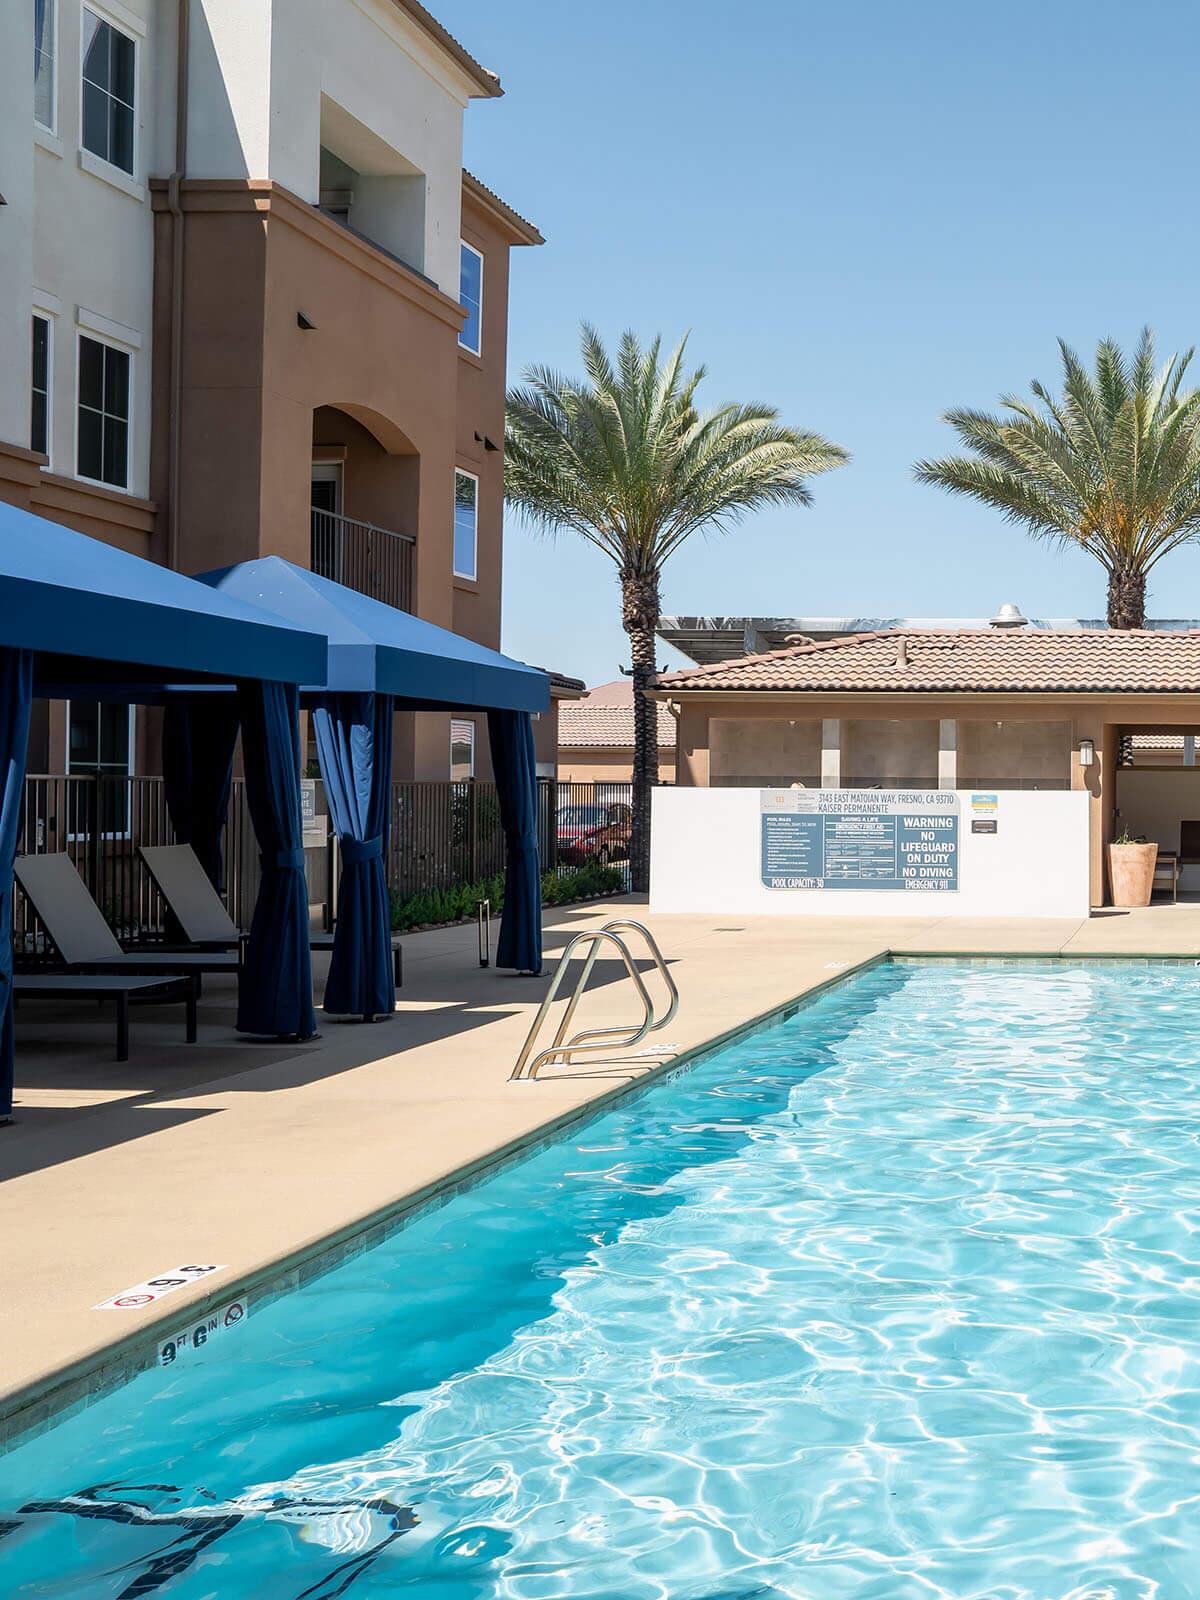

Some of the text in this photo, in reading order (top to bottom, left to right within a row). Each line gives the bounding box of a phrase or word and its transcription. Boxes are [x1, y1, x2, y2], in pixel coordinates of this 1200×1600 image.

[819, 794, 832, 802] 3143
[834, 794, 848, 803] EAST
[880, 794, 896, 804] WAY,
[898, 795, 925, 804] FRESNO,
[926, 795, 935, 804] CA
[936, 795, 954, 804] 93710
[819, 804, 889, 813] KAISER PERMANENTE
[904, 818, 953, 828] WARNING
[921, 832, 935, 841] NO
[901, 843, 955, 852] LIFEGUARD
[907, 854, 949, 863] ON DUTY
[902, 868, 953, 877] NO DIVING
[772, 879, 785, 888] POOL
[905, 880, 938, 889] EMERGENCY
